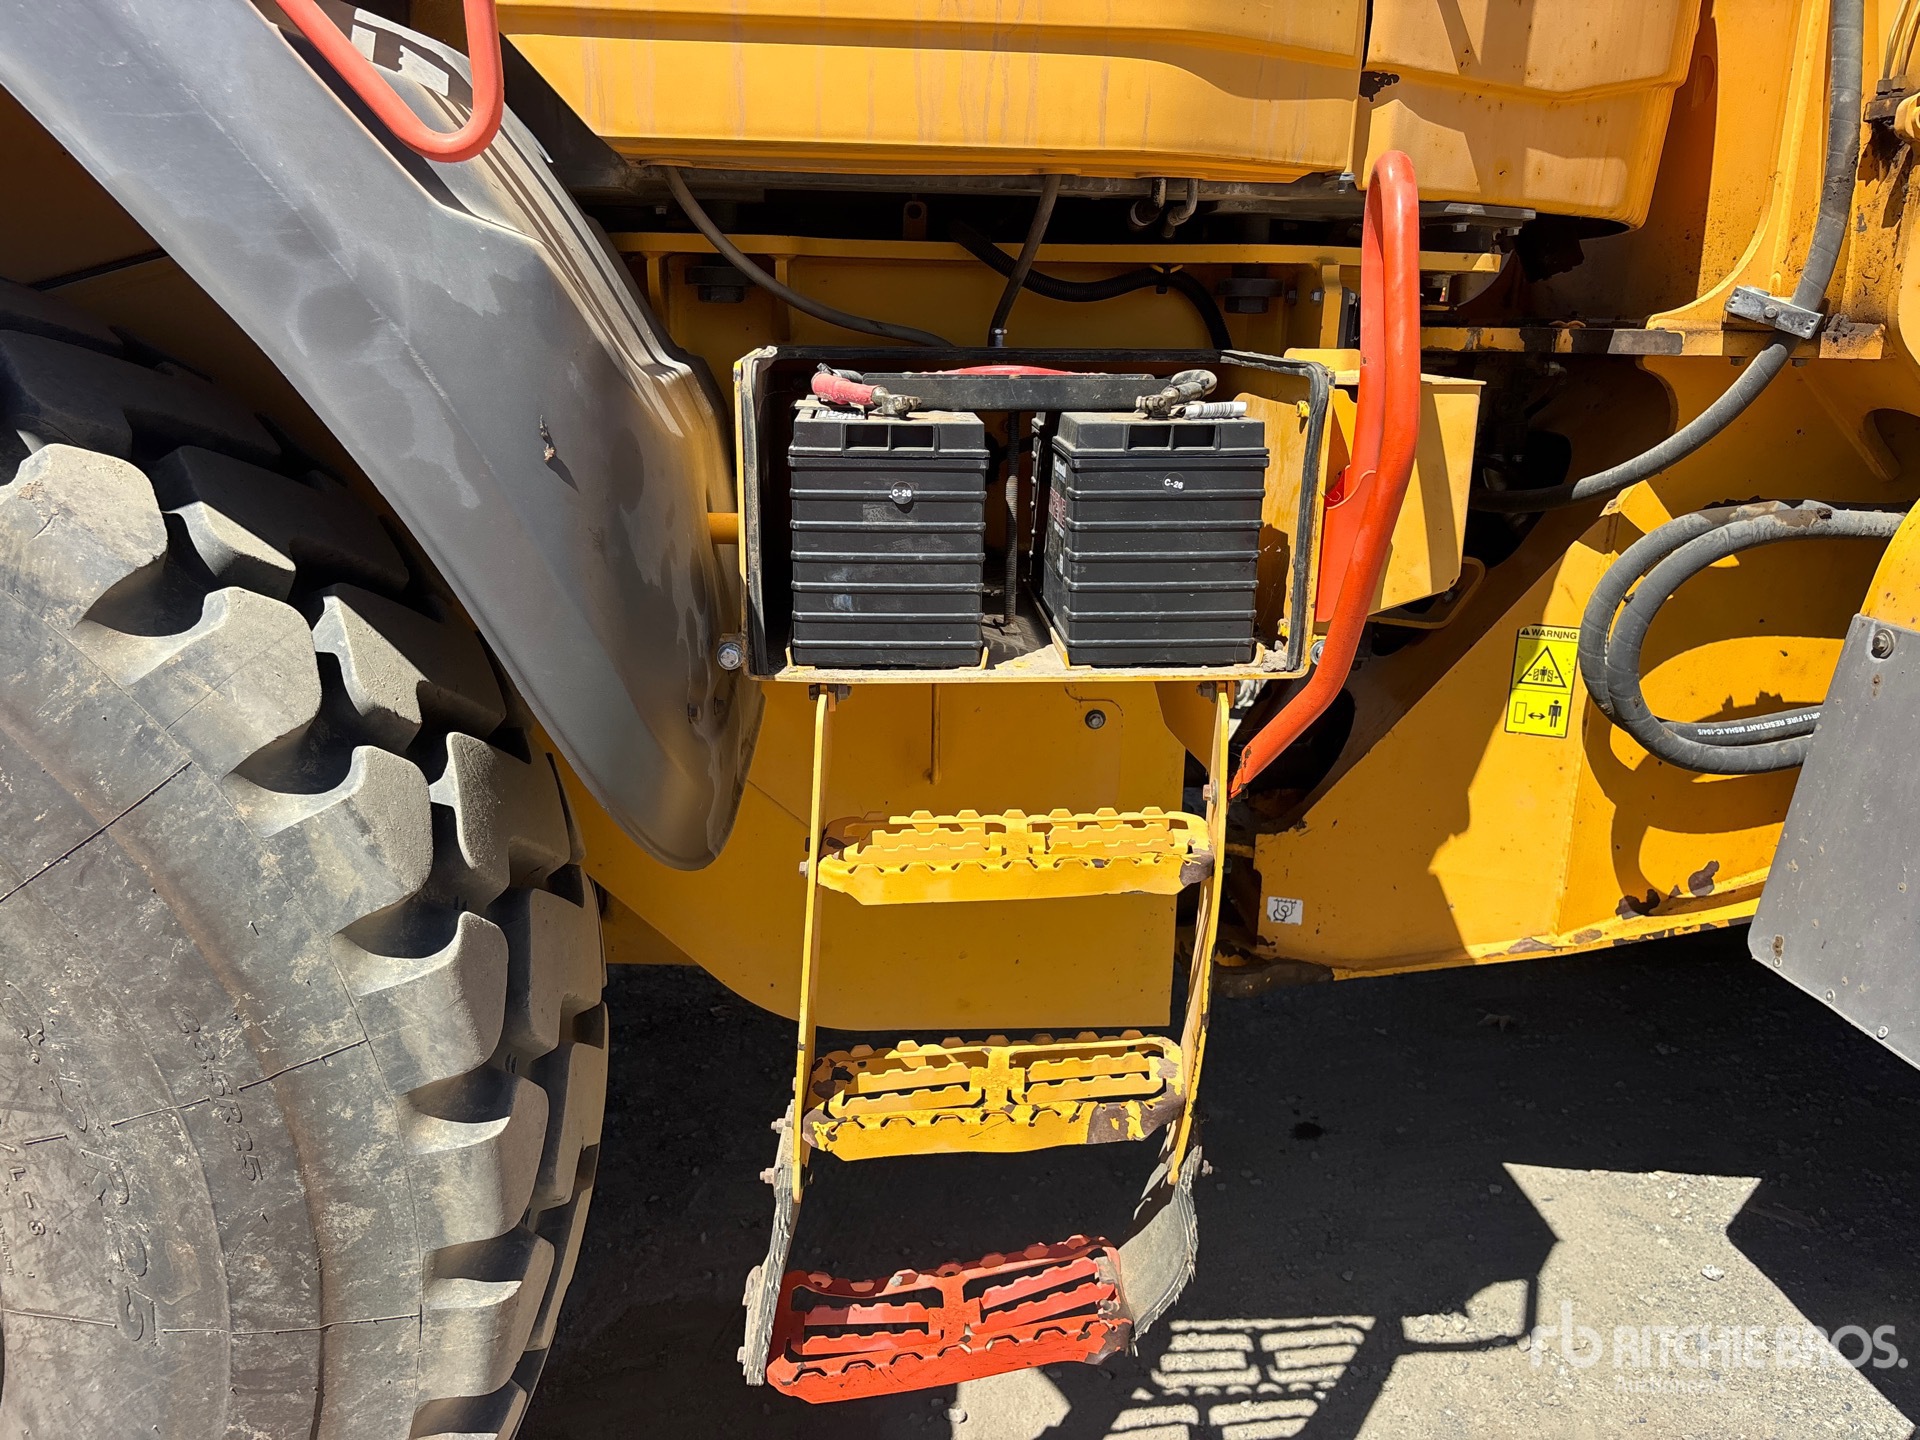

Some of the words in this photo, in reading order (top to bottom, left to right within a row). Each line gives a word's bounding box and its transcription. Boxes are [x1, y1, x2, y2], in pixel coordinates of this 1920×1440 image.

[892, 489, 912, 497] C-26
[1531, 628, 1578, 640] WARNING
[1746, 719, 1786, 732] RESISTANT
[1787, 715, 1804, 725] FIRE
[1725, 726, 1745, 734] MSHA
[170, 1005, 264, 1181] 23.5R25
